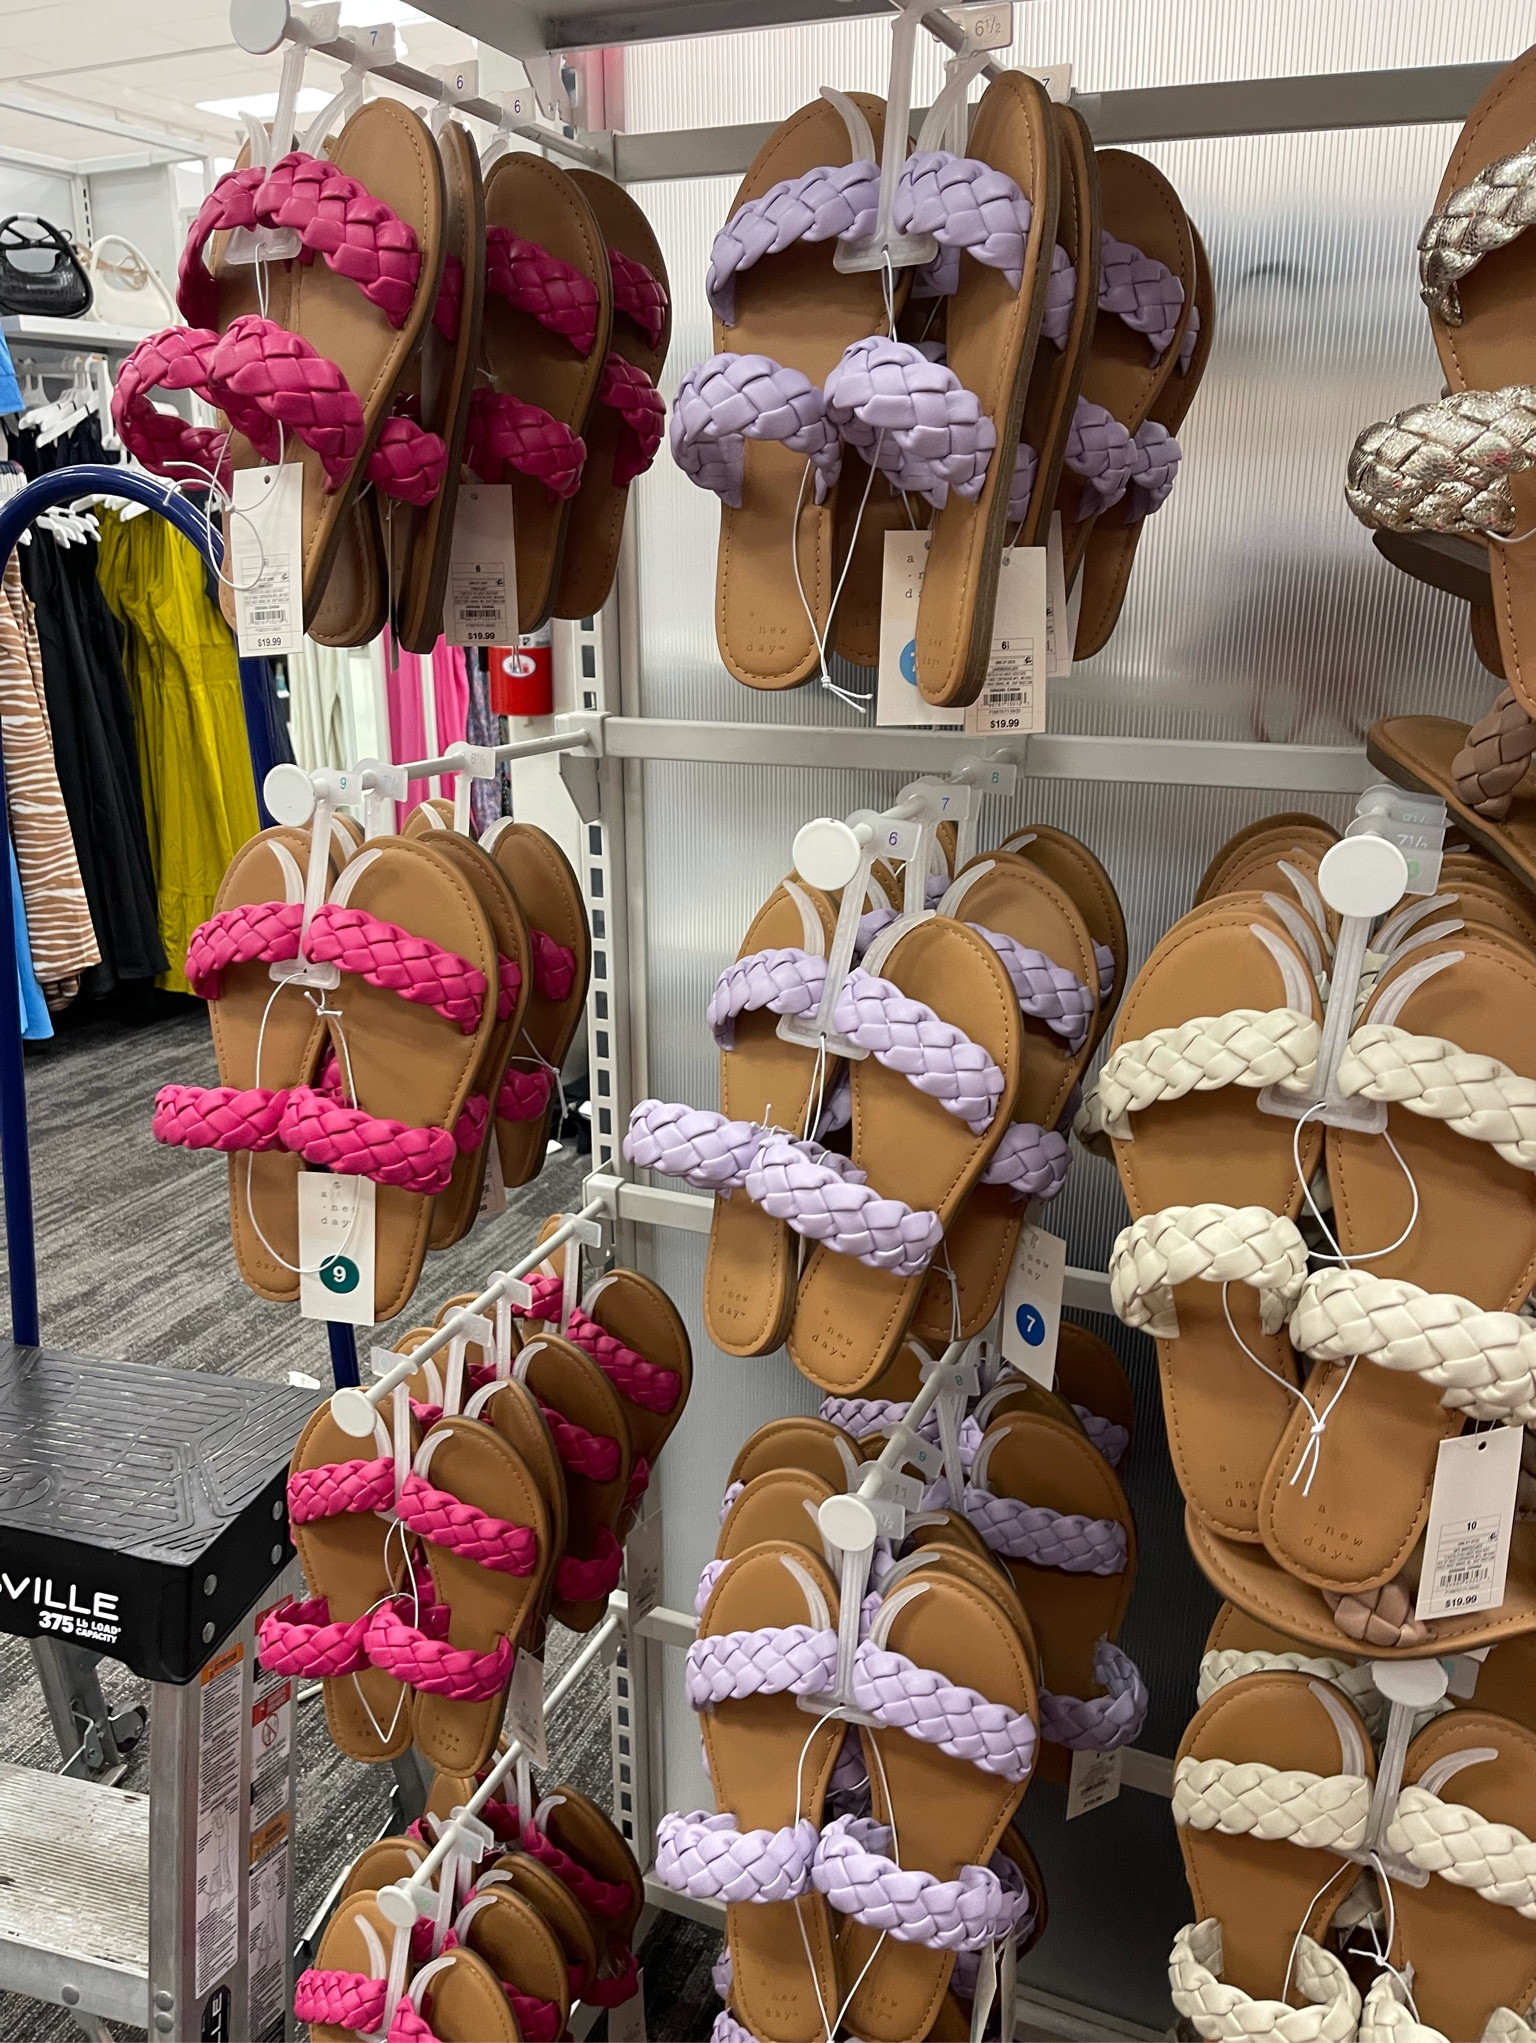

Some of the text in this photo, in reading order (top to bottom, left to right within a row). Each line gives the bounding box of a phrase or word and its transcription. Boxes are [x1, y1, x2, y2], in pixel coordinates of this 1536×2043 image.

[370, 30, 378, 46] 7
[456, 75, 463, 90] 6
[1042, 78, 1050, 88] 7
[514, 100, 520, 113] 6
[907, 554, 914, 563] a
[475, 564, 481, 573] 6
[257, 636, 282, 647] $19.99
[467, 631, 496, 640] $19.99
[990, 718, 1020, 729] $19.99
[340, 776, 347, 790] 9
[991, 772, 999, 784] 8
[942, 797, 950, 811] 7
[888, 831, 898, 846] 6
[333, 1265, 347, 1283] 9
[1027, 1315, 1036, 1333] 7
[827, 1326, 853, 1346] new
[1235, 1480, 1263, 1489] ne
[1466, 1521, 1477, 1530] 10
[1326, 1525, 1363, 1547] new
[0, 1572, 119, 1621] VILLE
[1445, 1594, 1478, 1609] $19.99
[39, 1610, 74, 1633] 375
[76, 1618, 88, 1628] Lb
[75, 1627, 118, 1643] CAPACITY
